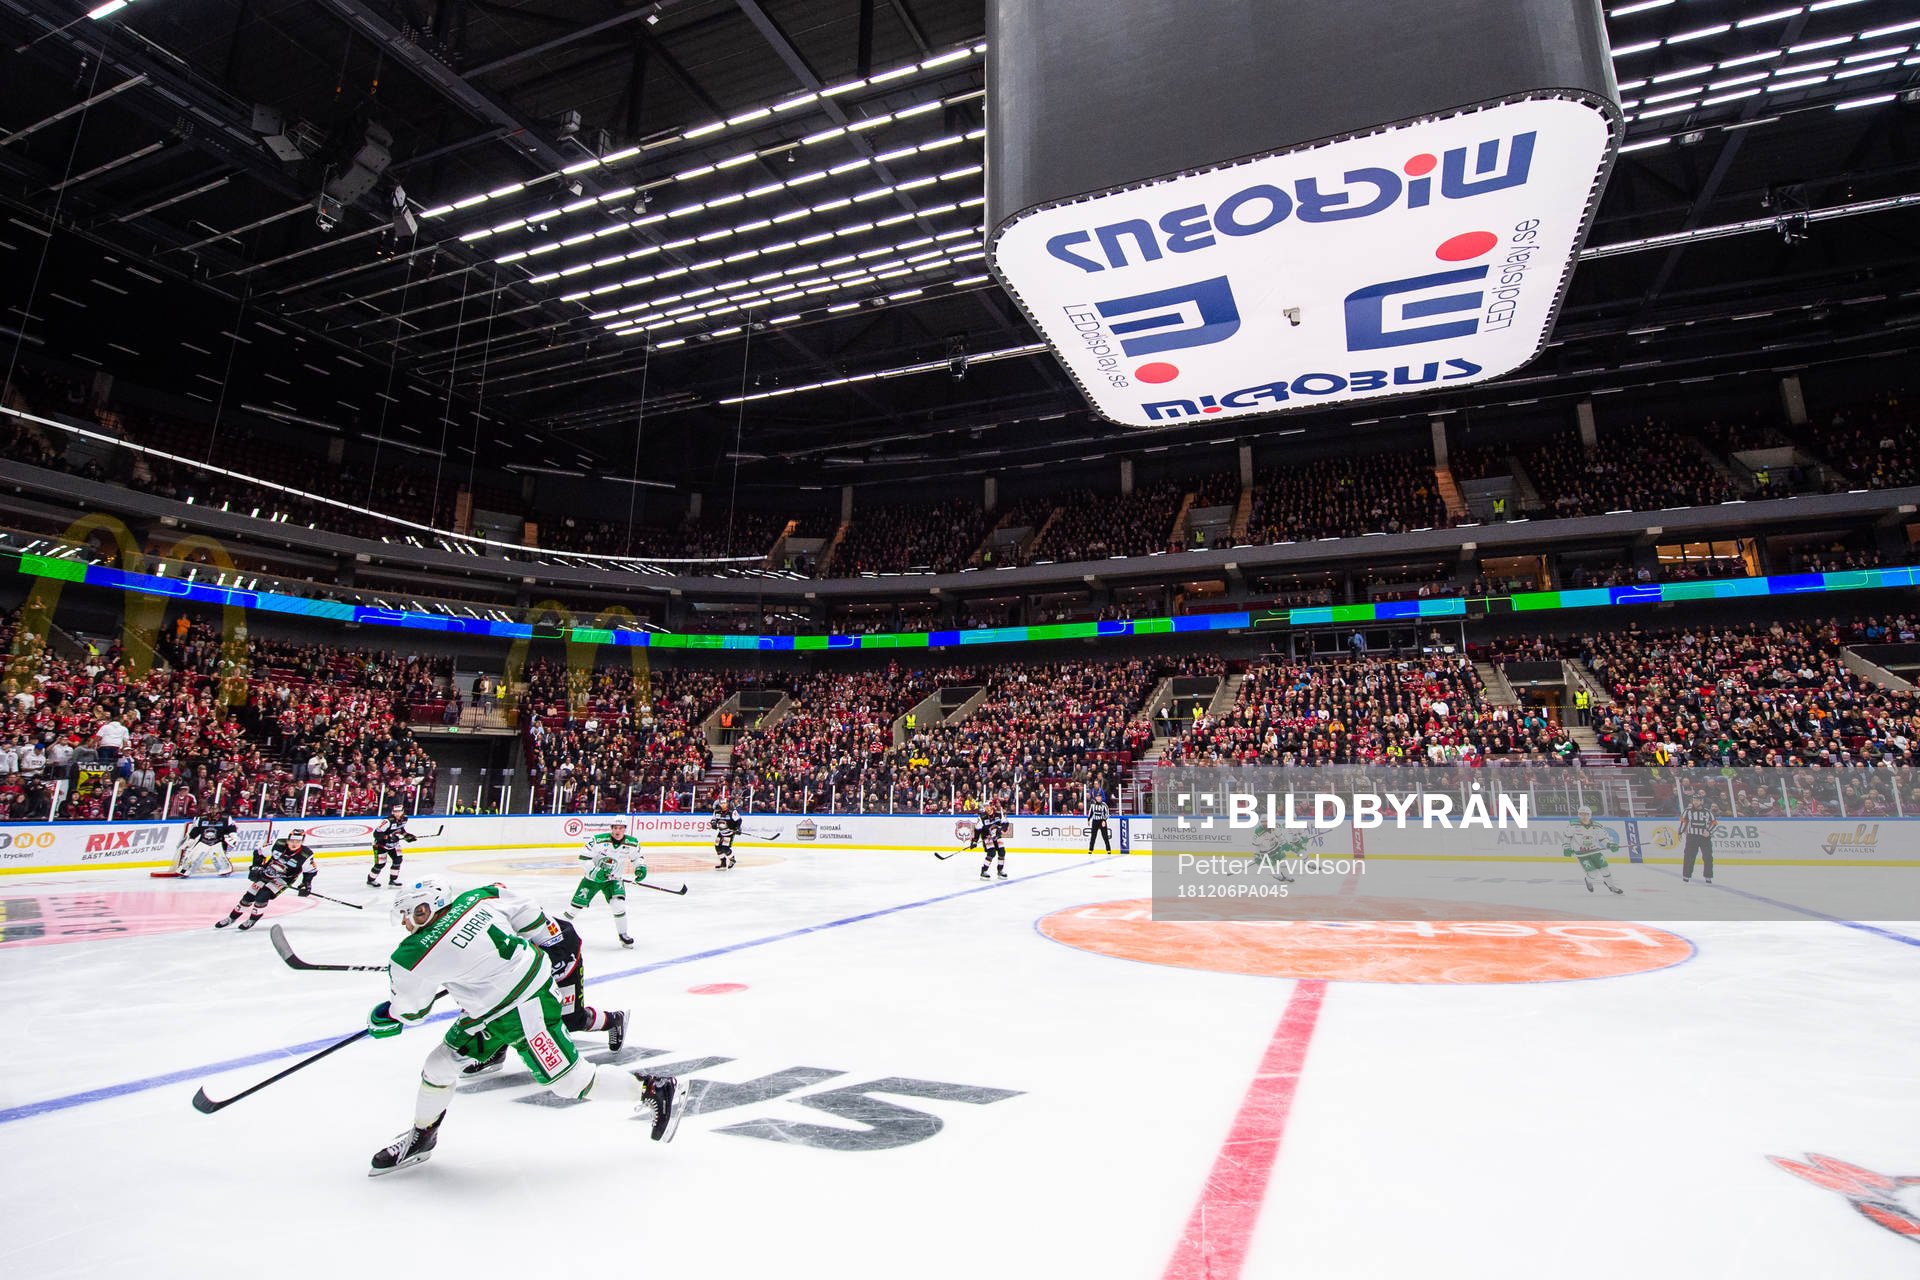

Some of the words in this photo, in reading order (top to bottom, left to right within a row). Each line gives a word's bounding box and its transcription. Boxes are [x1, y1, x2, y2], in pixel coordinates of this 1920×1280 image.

[1484, 218, 1540, 334] LEDdisplay.se
[1062, 303, 1130, 390] LEDdisplay.se
[636, 819, 713, 834] holmbergs
[1162, 825, 1197, 833] MALMÖ
[1711, 825, 1760, 839] SAB
[1826, 823, 1880, 846] guld
[1134, 833, 1233, 841] STÄLLNINGSSERVICE
[1497, 830, 1567, 845] ALLIAN
[104, 849, 129, 857] MUSIK
[131, 846, 149, 854] JUST
[450, 908, 494, 950] CURRAN
[534, 1036, 558, 1067] ER-HO
[545, 1037, 559, 1055] BYGG
